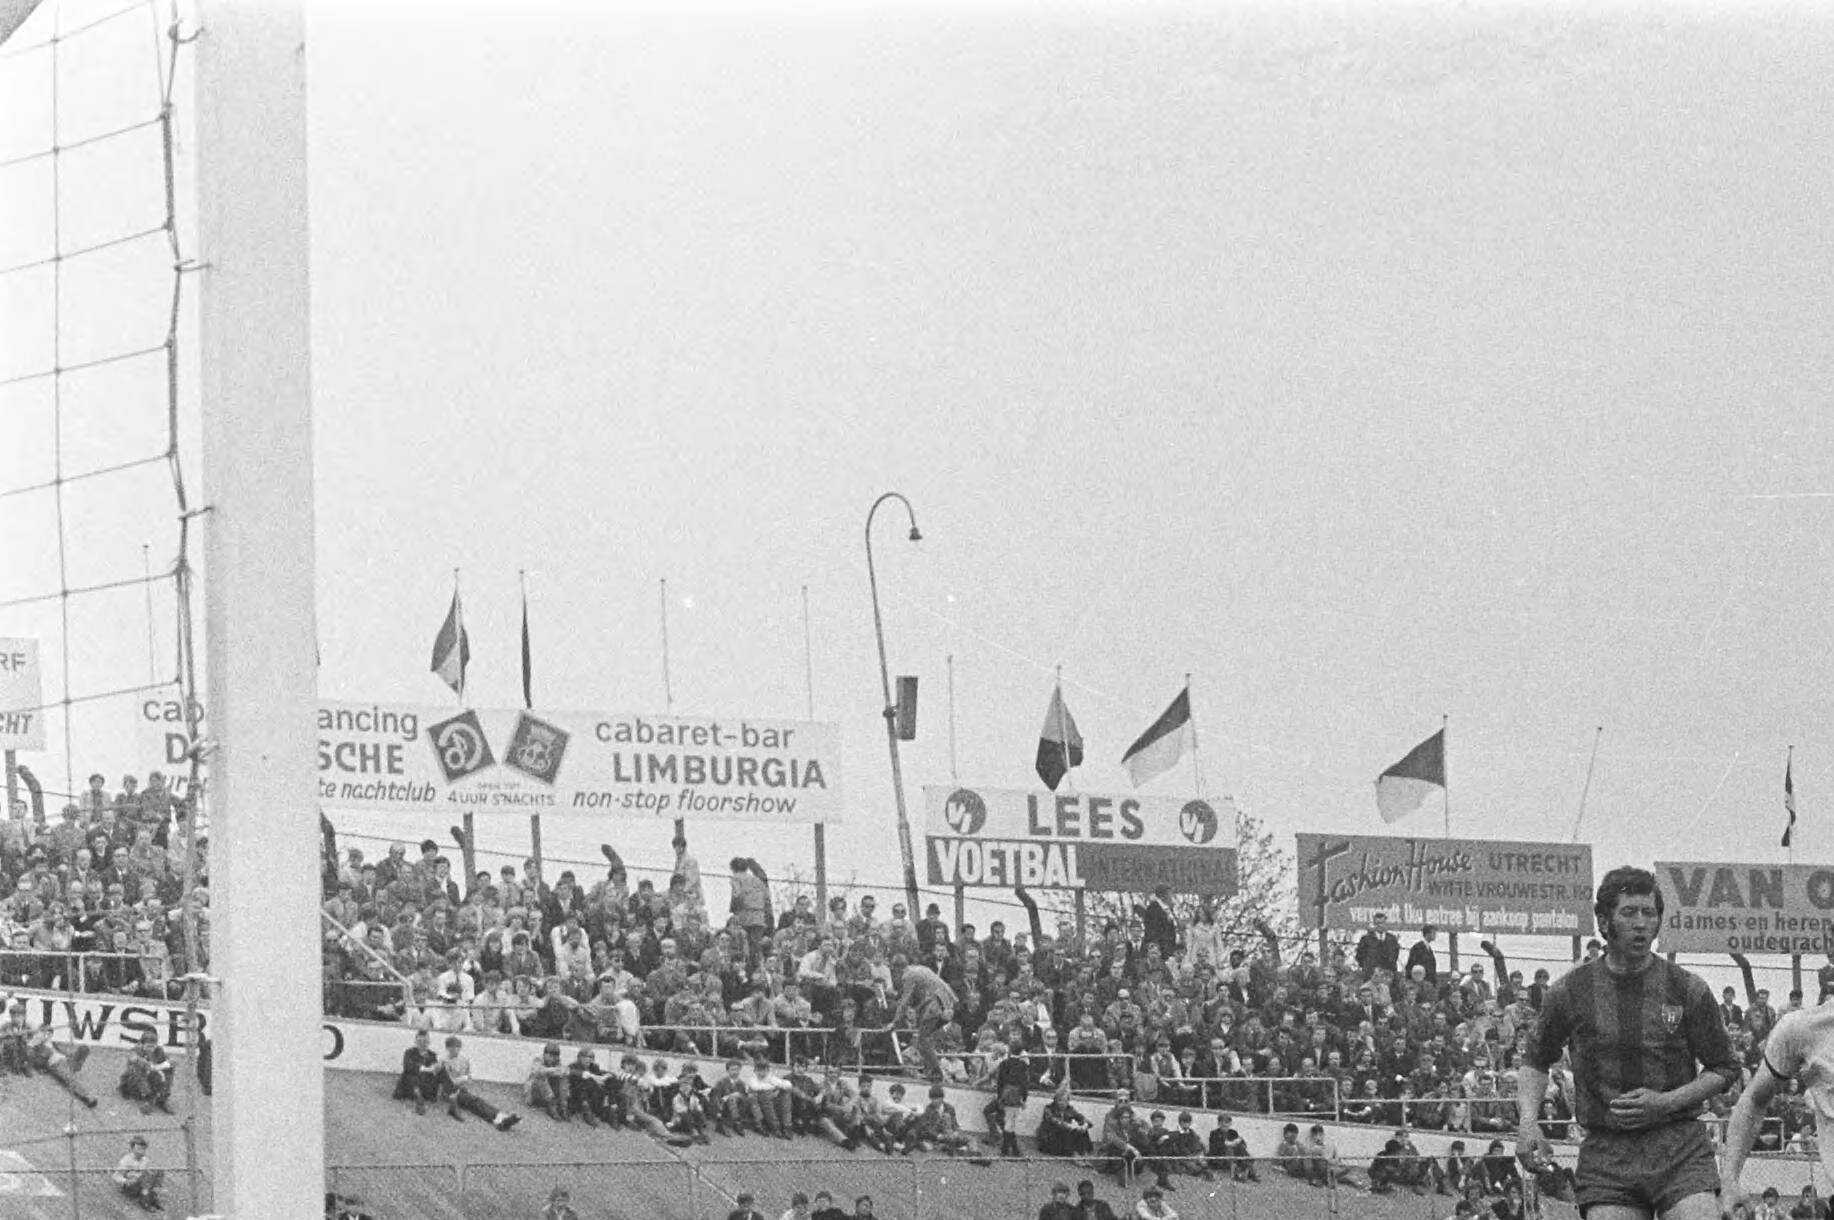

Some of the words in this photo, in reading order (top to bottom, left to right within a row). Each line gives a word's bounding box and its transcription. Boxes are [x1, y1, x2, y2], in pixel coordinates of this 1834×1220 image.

[595, 718, 795, 749] cabaret-bar
[612, 752, 828, 790] LIMBURGIA
[341, 778, 436, 803] nachtclub
[459, 793, 488, 806] UUR
[572, 788, 671, 815] non-stop
[676, 788, 798, 814] floorshow
[1027, 794, 1145, 840] LEES
[934, 838, 1086, 888] VOETBAL
[1308, 841, 1408, 928] Fashion
[1405, 840, 1473, 893] House
[1488, 852, 1582, 874] UTRECHT
[1668, 867, 1785, 908] VAN
[1748, 916, 1769, 930] en
[1727, 932, 1834, 951] oudegrach
